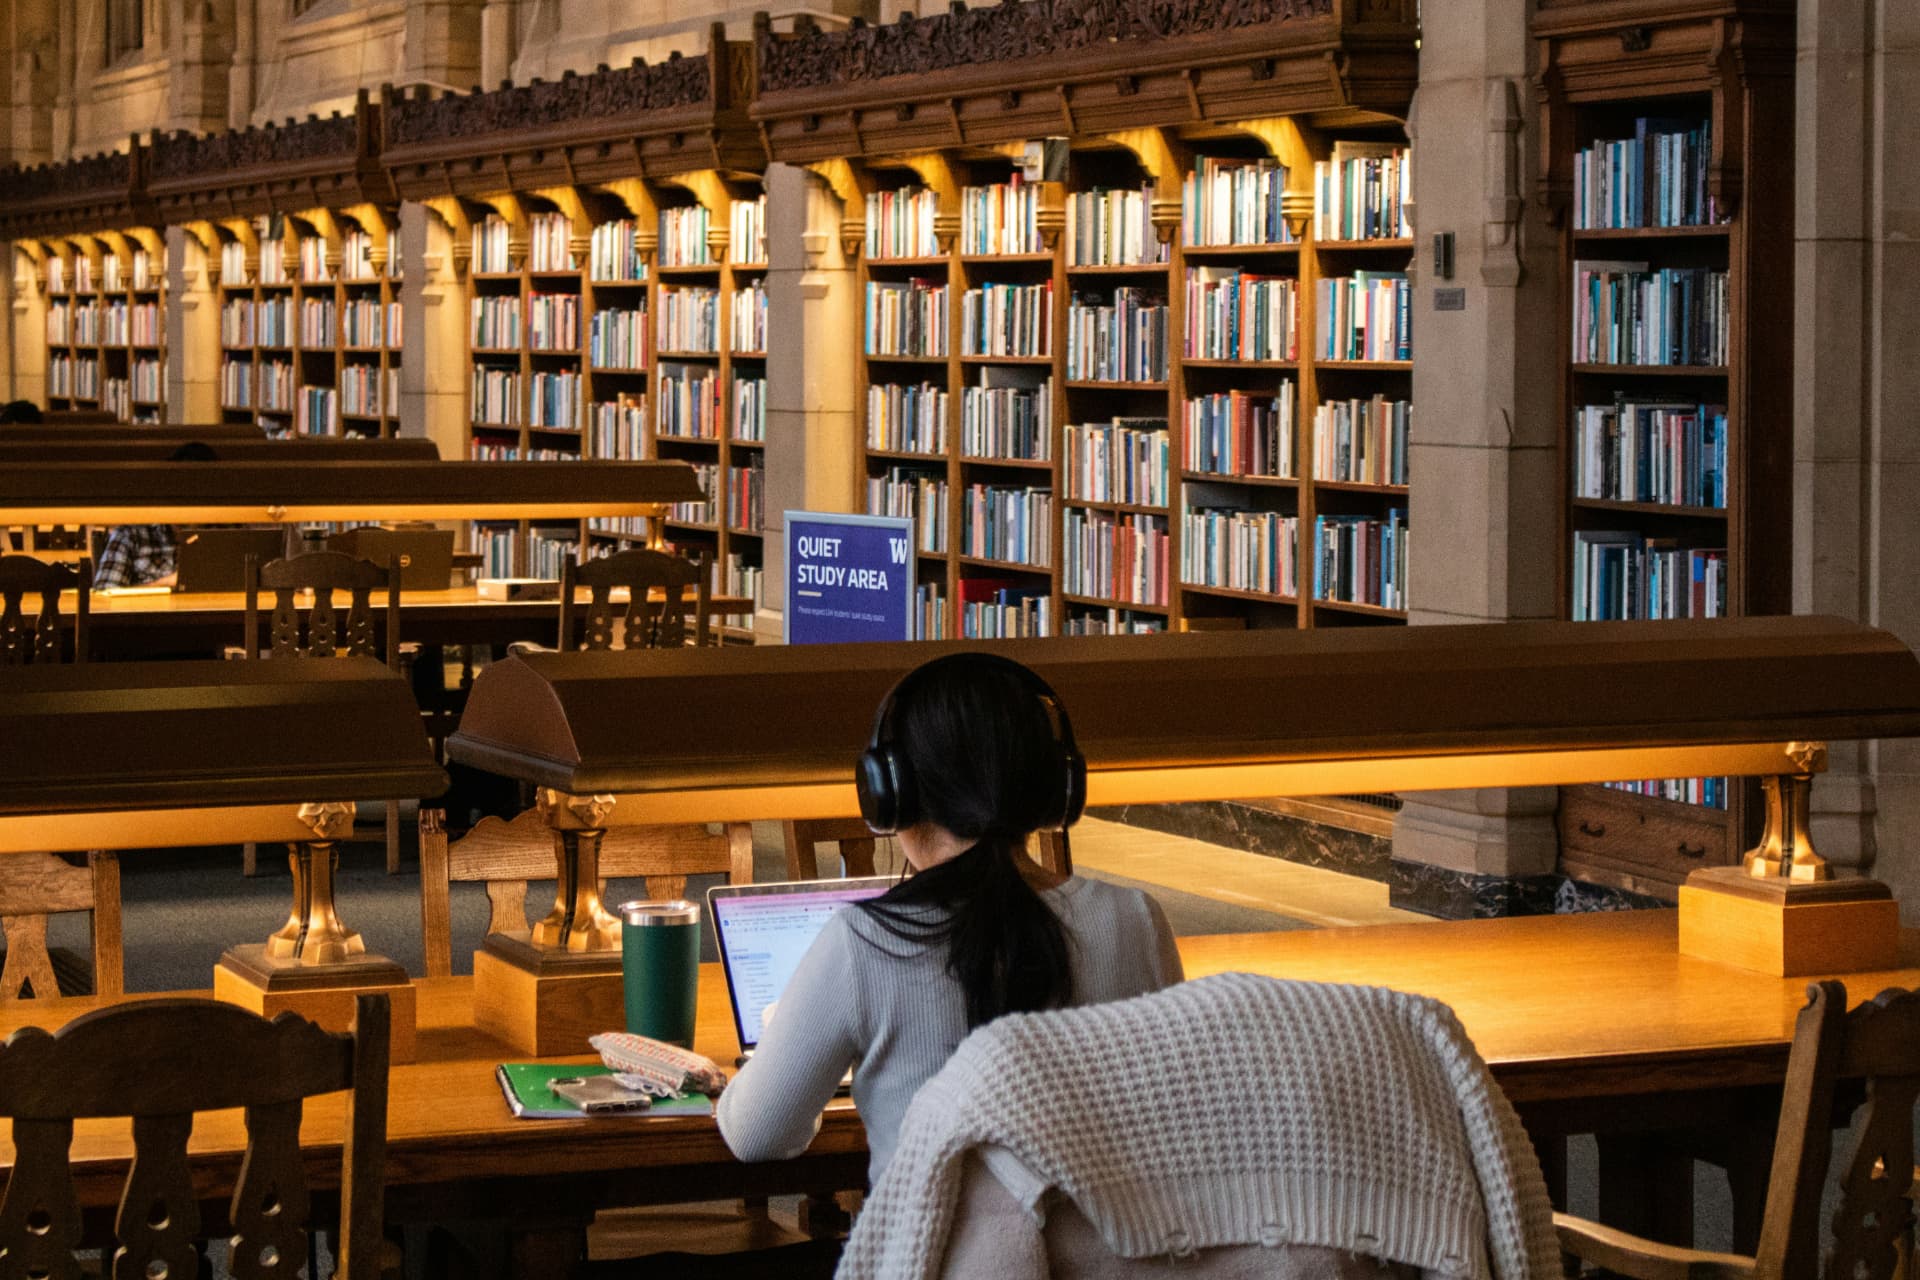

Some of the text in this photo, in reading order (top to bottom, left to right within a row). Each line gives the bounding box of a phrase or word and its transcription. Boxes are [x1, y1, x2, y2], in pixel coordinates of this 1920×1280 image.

[798, 536, 842, 559] QUIET
[889, 538, 908, 565] W
[798, 564, 889, 591] STUDY AREA
